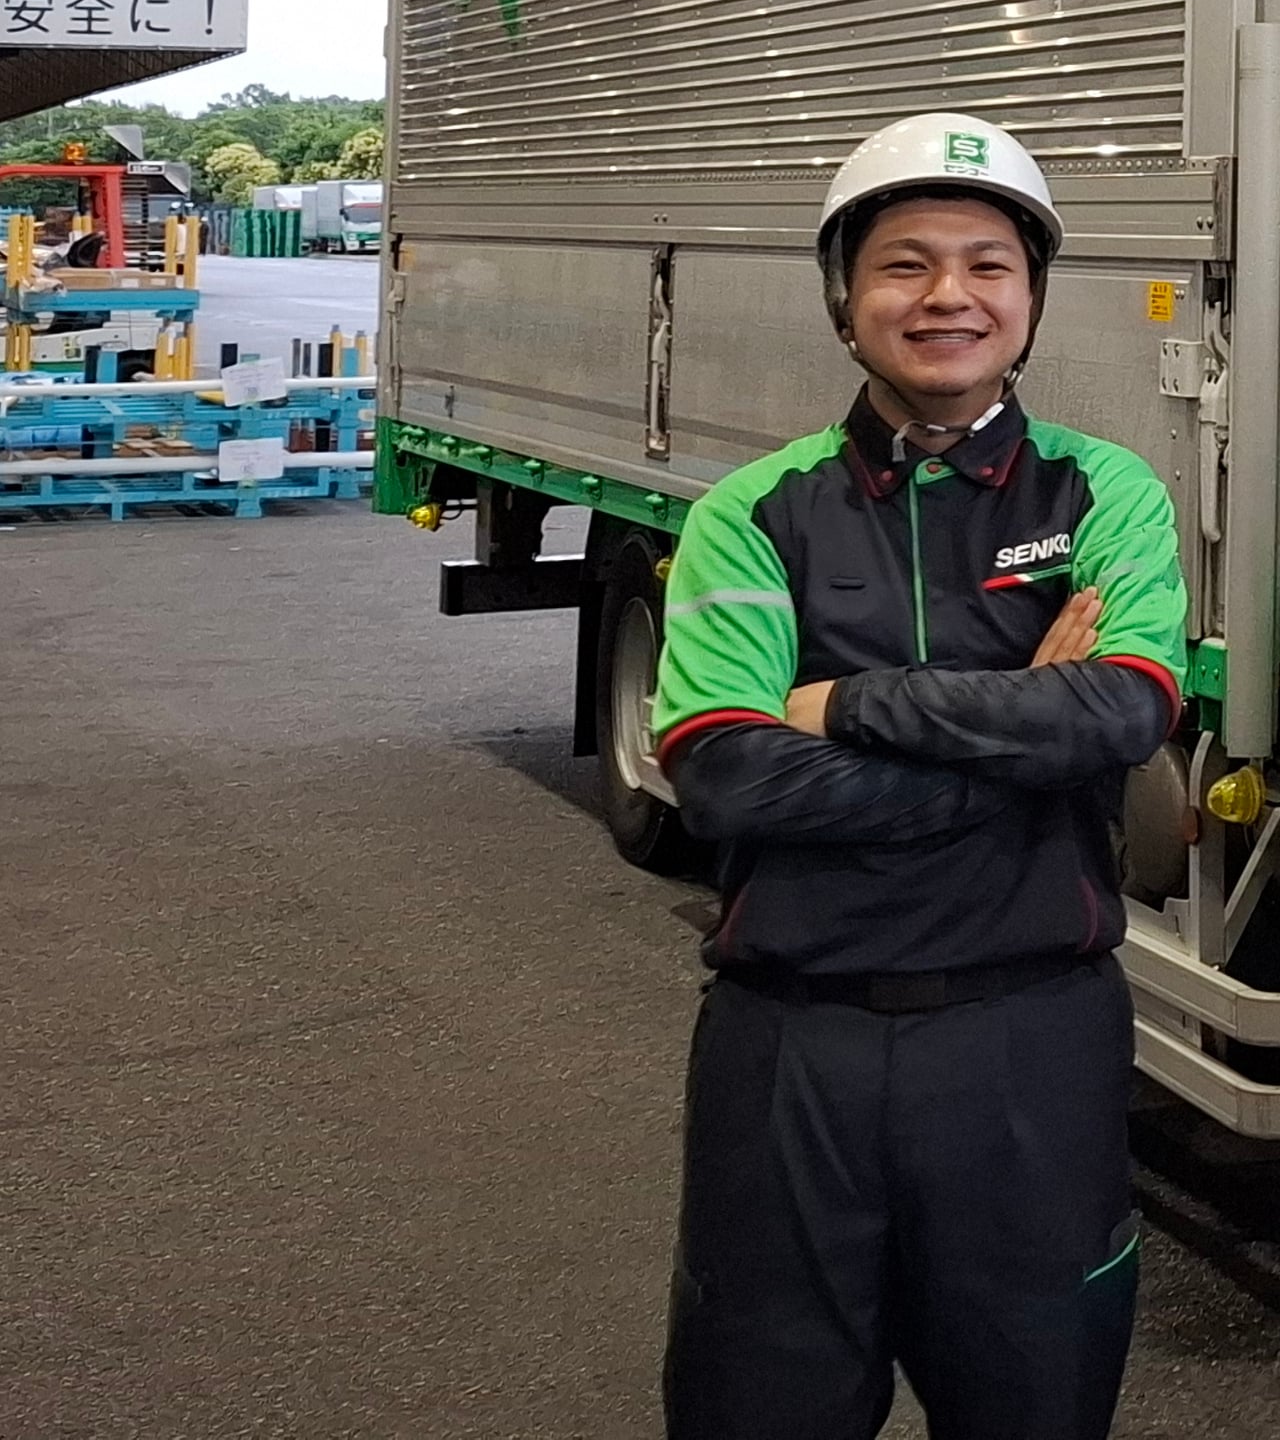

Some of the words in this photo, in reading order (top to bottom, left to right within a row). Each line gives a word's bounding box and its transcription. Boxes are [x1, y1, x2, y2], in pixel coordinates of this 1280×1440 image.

[943, 164, 990, 177] センコー
[993, 533, 1071, 569] SENKO
